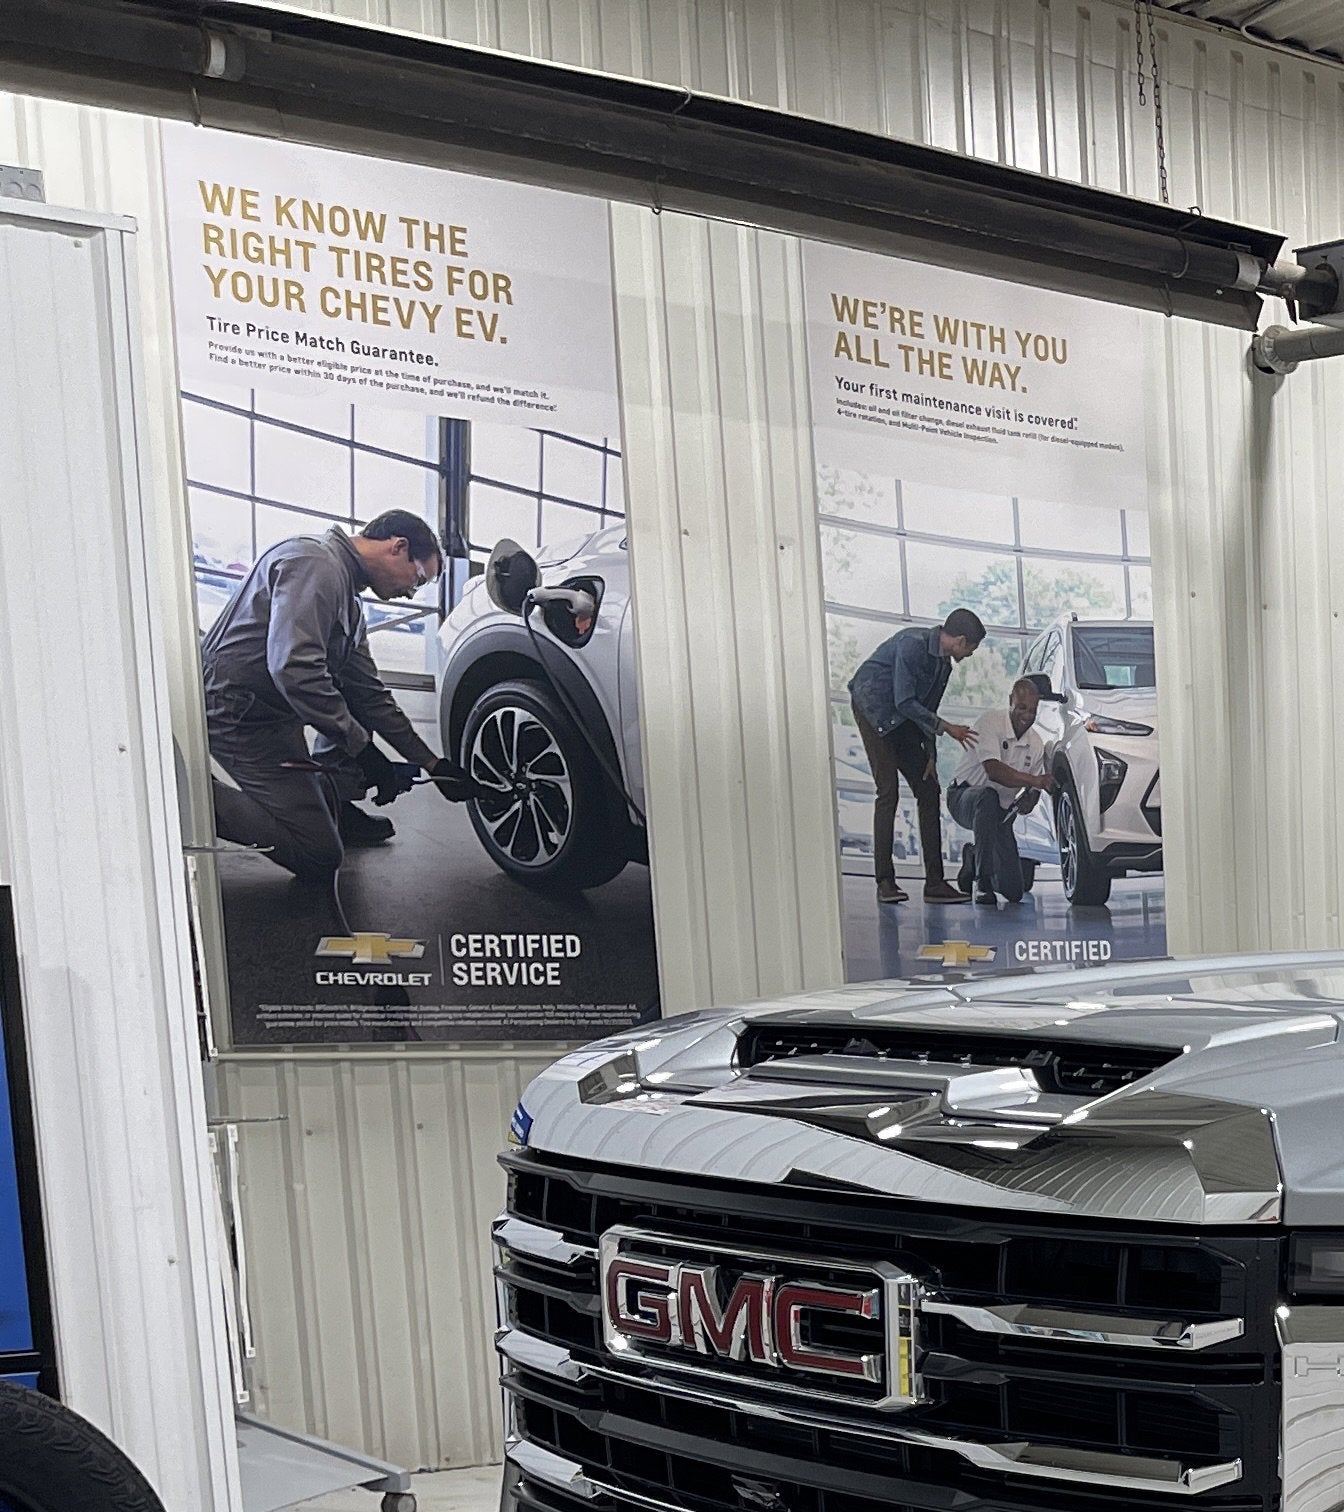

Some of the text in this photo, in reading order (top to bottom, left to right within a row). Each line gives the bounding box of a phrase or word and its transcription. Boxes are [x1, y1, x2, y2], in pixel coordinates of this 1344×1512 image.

[198, 180, 468, 257] WE KNOW THE
[203, 222, 513, 305] RIGHT TIRES FOR
[203, 264, 507, 344] YOUR CHEVY EV.
[831, 293, 1067, 364] WE'RE WITH YOU
[206, 315, 439, 367] Tire Price Match Guarantee.
[834, 331, 1027, 393] ALL THE WAY.
[208, 341, 242, 354] Provide
[244, 349, 255, 357] us
[257, 350, 277, 360] with
[287, 354, 314, 366] better
[317, 359, 348, 371] eligible
[350, 365, 373, 376] price
[374, 369, 383, 377] at
[385, 369, 399, 379] the
[401, 372, 420, 382] time
[423, 375, 431, 384] of
[433, 377, 474, 391] purchase,
[476, 383, 491, 392] and
[493, 386, 511, 394] we'll
[513, 388, 539, 399] match
[540, 391, 550, 400] it.
[209, 353, 229, 364] Find
[239, 358, 267, 370] better
[269, 364, 292, 375] price
[294, 367, 321, 379] within
[323, 371, 334, 380] 30
[337, 374, 356, 385] days
[358, 377, 368, 386] of
[369, 379, 383, 388] the
[386, 382, 427, 396] purchase,
[429, 388, 444, 397] and
[447, 391, 466, 399] we'll
[467, 393, 495, 404] refund
[497, 396, 511, 406] the
[835, 376, 866, 394] Your
[869, 383, 897, 401] first
[901, 391, 981, 416] maintenance
[985, 405, 1011, 421] visit
[1014, 409, 1024, 423] is
[450, 934, 581, 958] CERTIFIED
[452, 962, 561, 986] SERVICE
[1014, 940, 1111, 961] CERTIFIED
[315, 972, 432, 987] CHEVROLET
[606, 1250, 884, 1387] GMC
